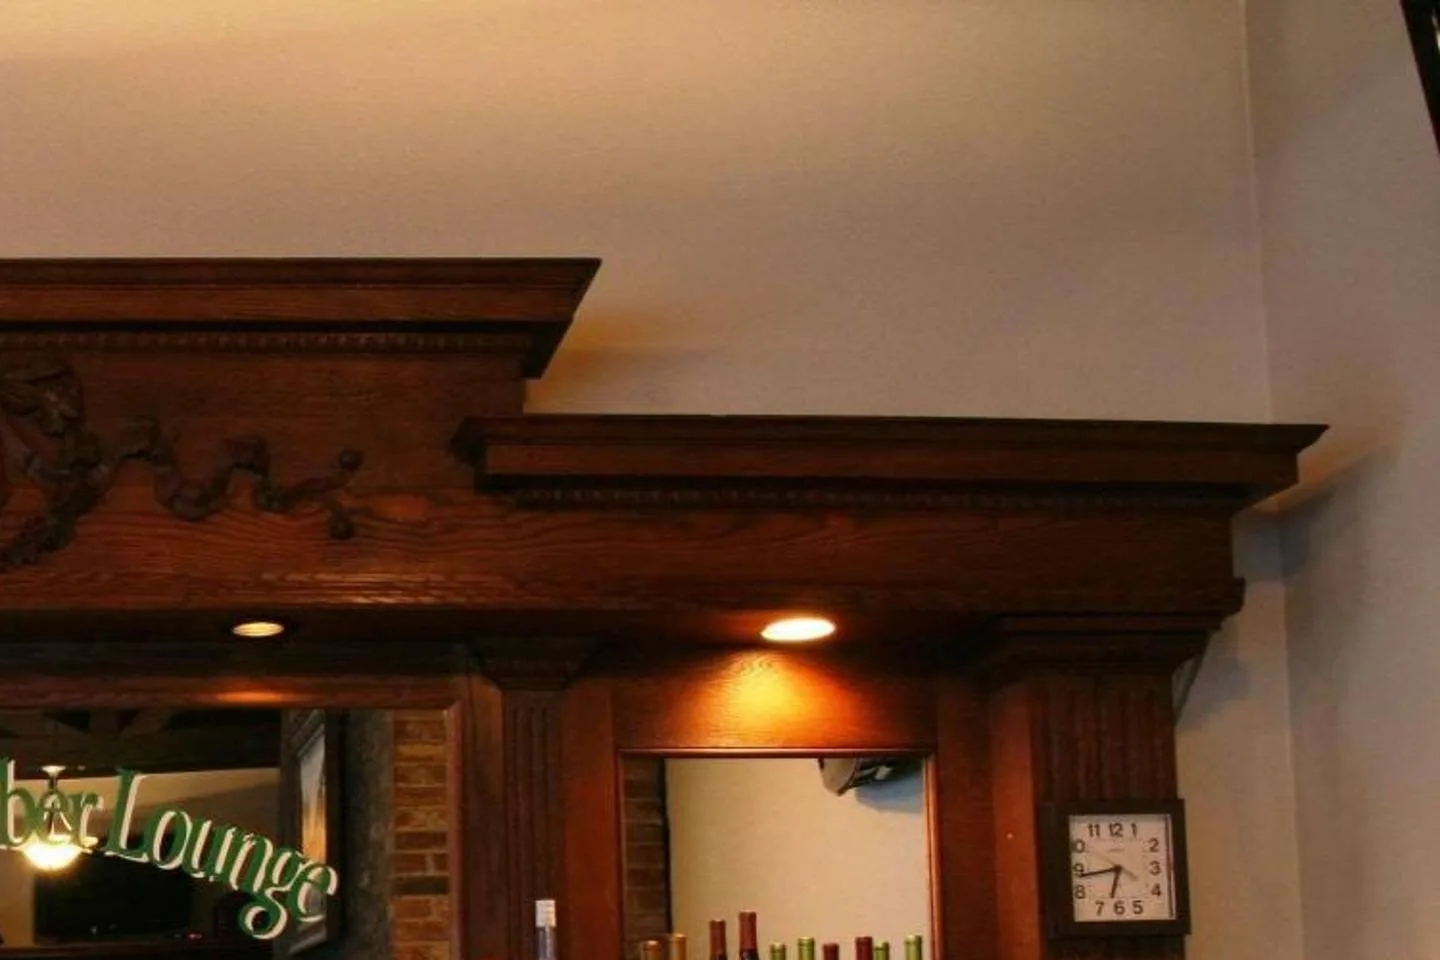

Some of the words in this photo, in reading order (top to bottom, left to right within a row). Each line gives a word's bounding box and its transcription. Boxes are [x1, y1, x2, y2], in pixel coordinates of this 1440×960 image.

[1088, 823, 1101, 838] 11
[1109, 822, 1123, 838] 12
[1131, 822, 1138, 839] 1
[1148, 837, 1160, 853] 2
[102, 767, 338, 940] Lounge
[1072, 862, 1085, 878] 9
[1149, 860, 1161, 876] 3
[1074, 884, 1086, 899] 8
[1151, 883, 1162, 897] 4
[1095, 901, 1105, 916] 7
[1113, 901, 1126, 915] 6
[1132, 900, 1144, 915] 5
